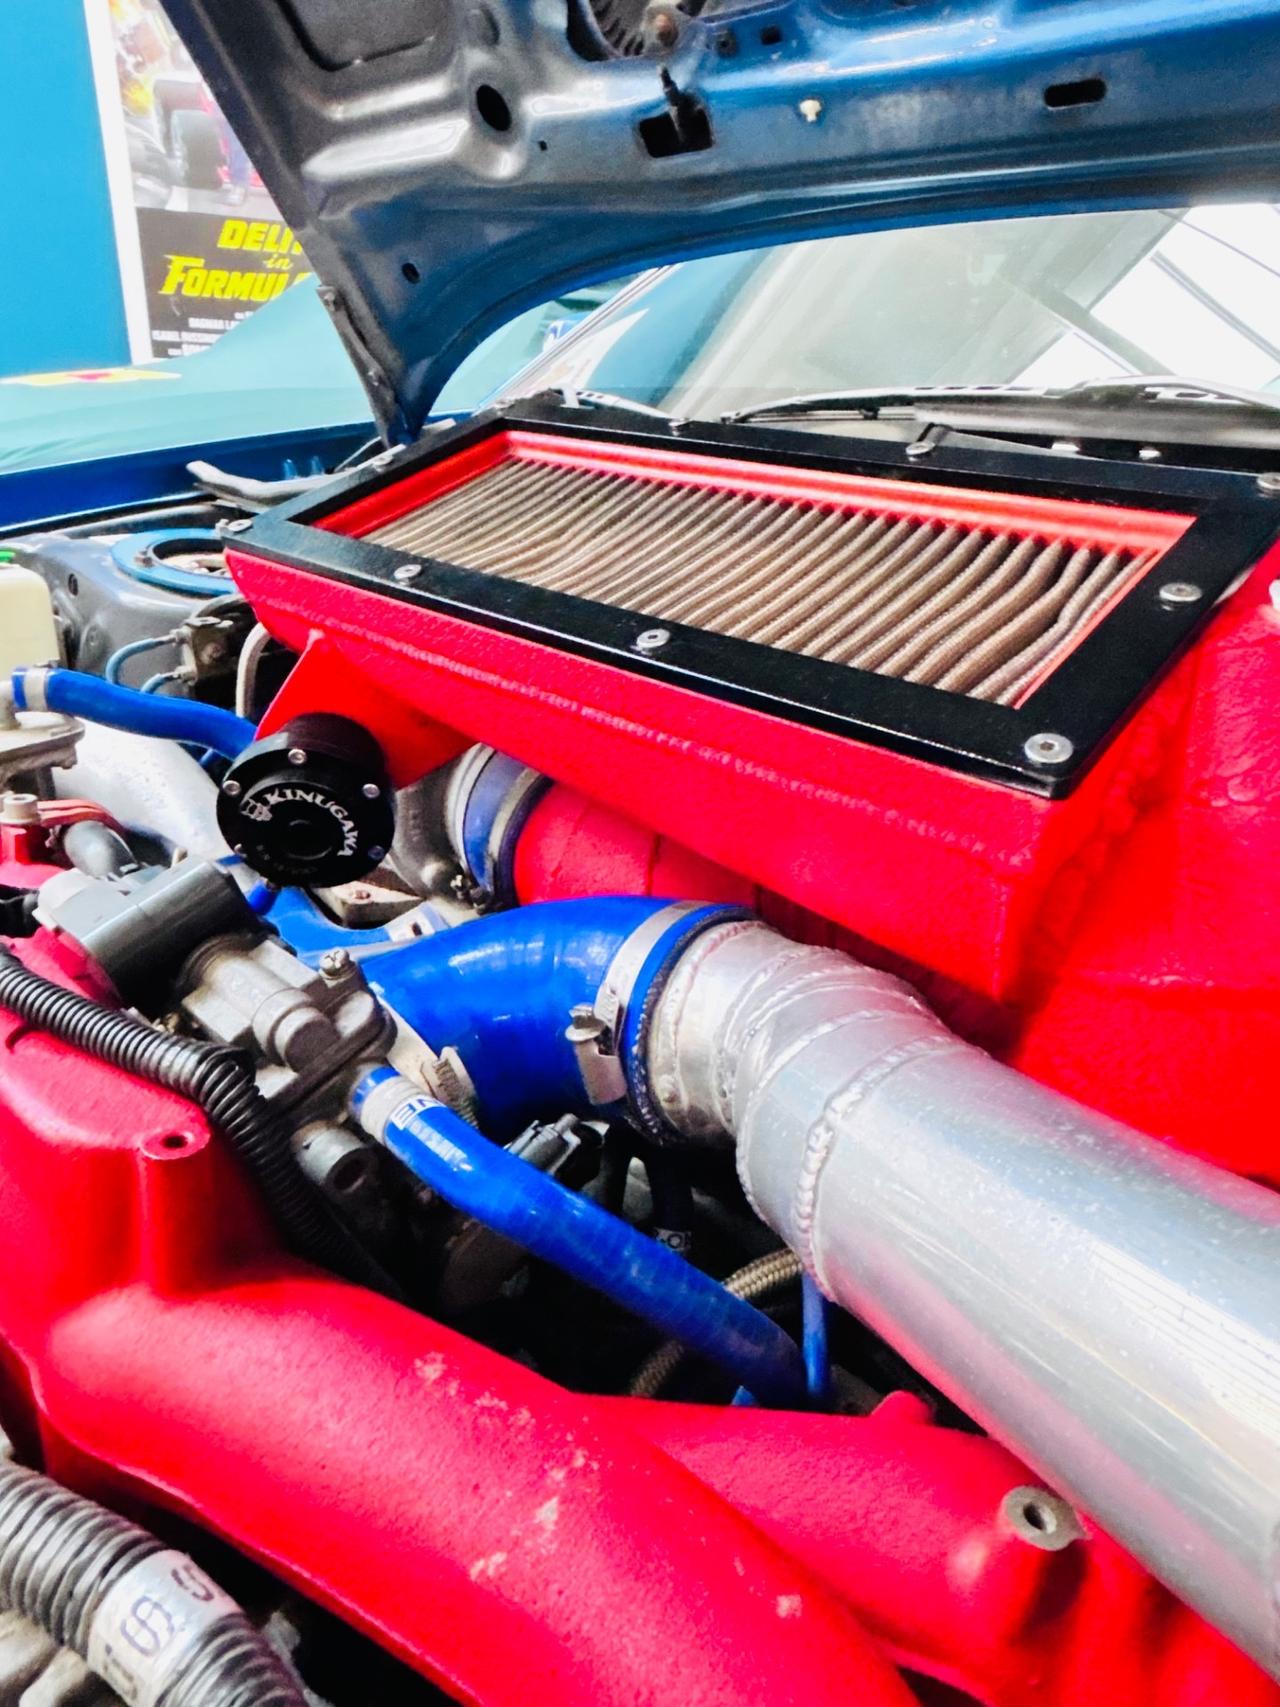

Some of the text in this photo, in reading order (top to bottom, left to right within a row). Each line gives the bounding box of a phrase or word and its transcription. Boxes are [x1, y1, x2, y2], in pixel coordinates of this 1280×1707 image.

[158, 254, 313, 302] FORMUL
[262, 253, 293, 270] in
[263, 788, 358, 856] KINUGAWA
